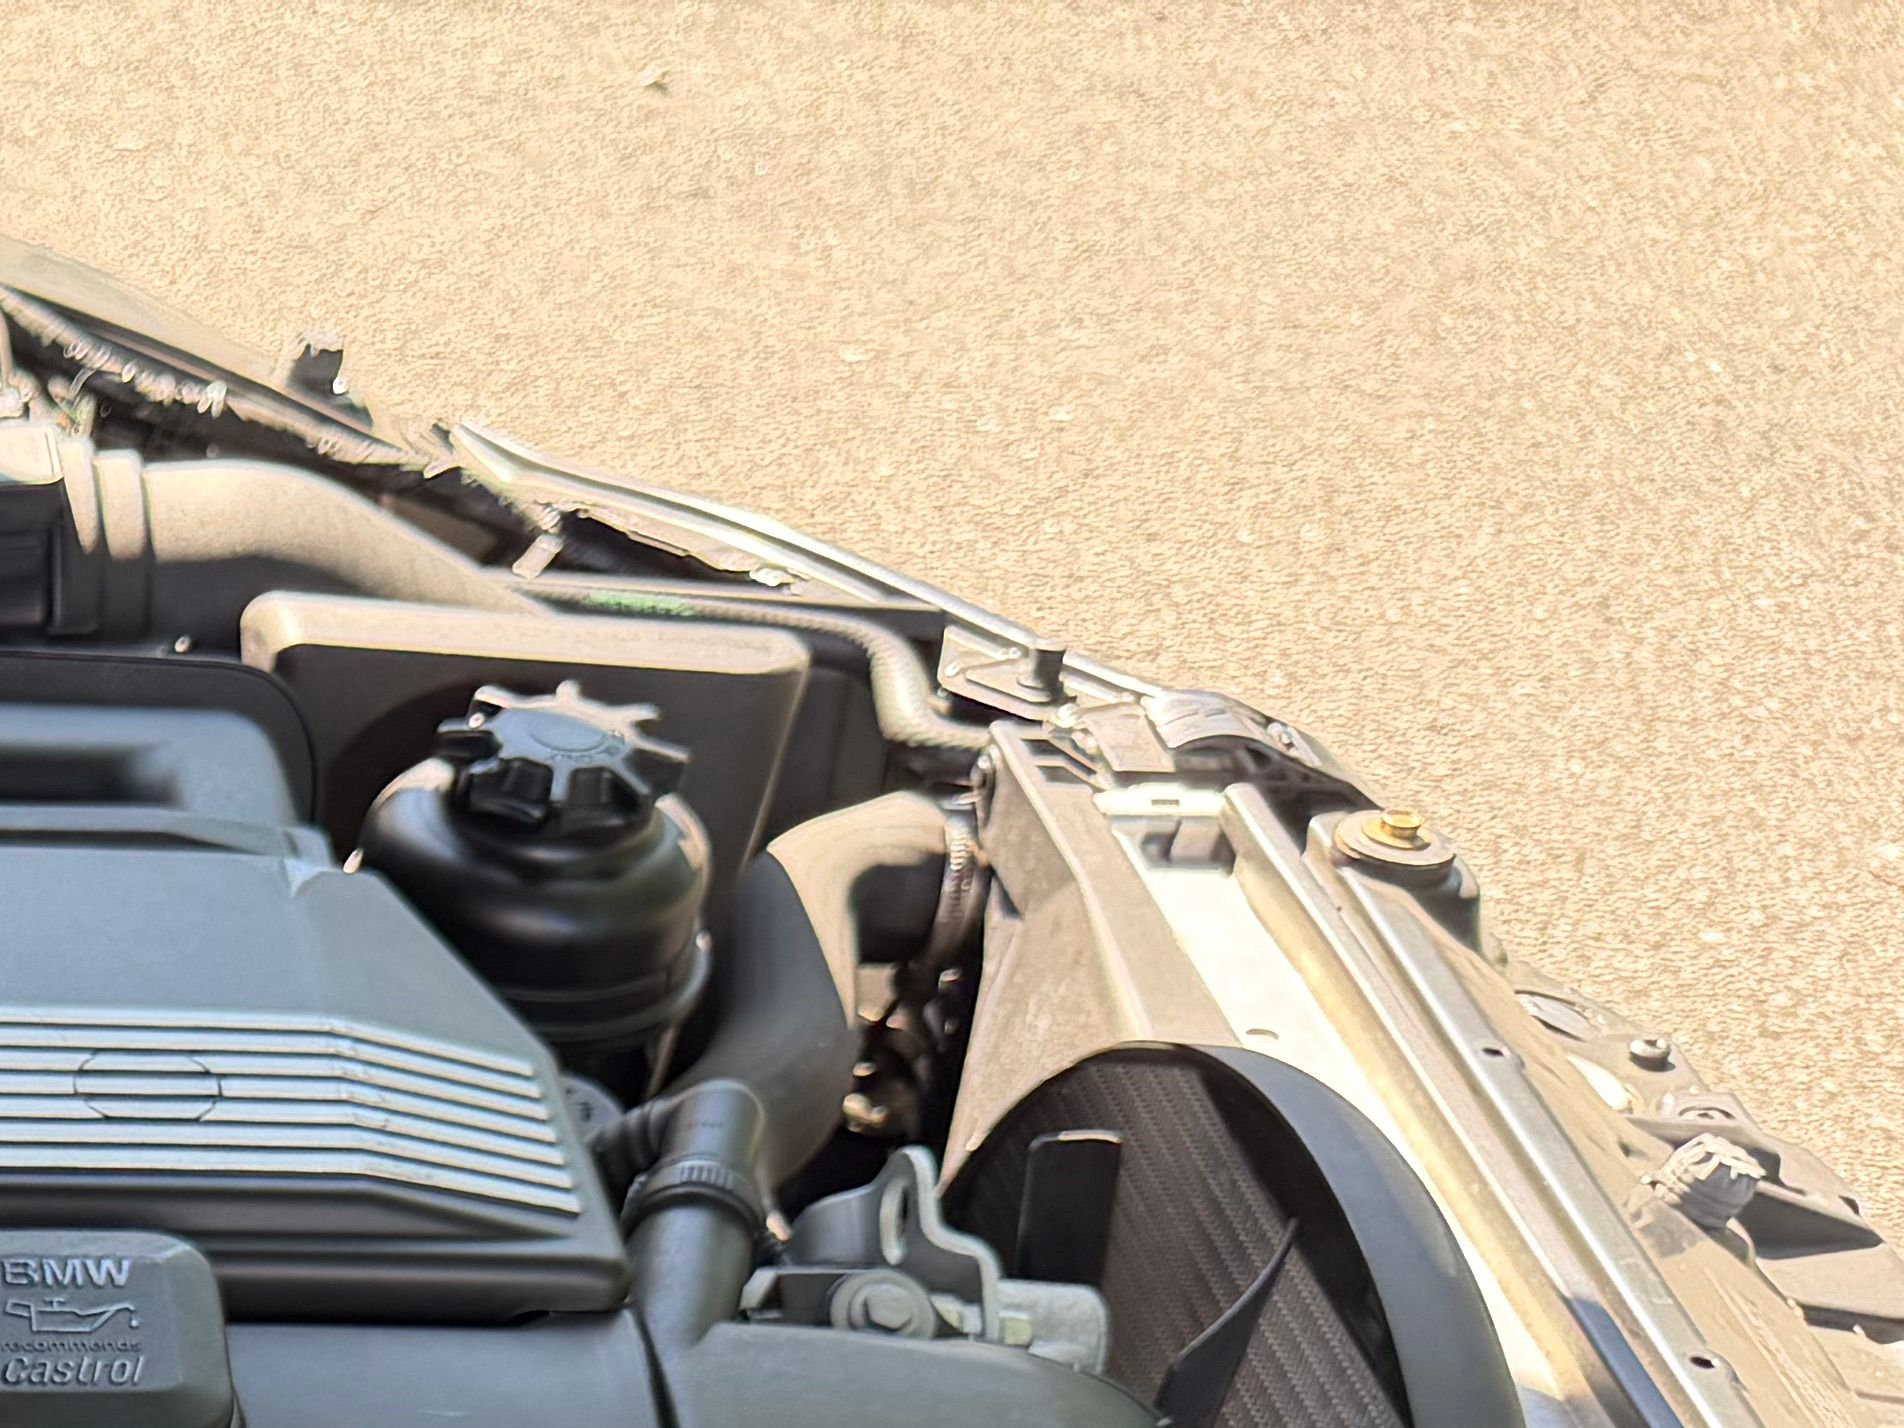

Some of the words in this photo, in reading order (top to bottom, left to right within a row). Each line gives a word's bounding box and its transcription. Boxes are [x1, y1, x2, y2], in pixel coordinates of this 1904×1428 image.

[0, 1257, 132, 1289] BMW
[0, 1338, 145, 1354] recommends
[0, 1354, 145, 1387] Castrol
